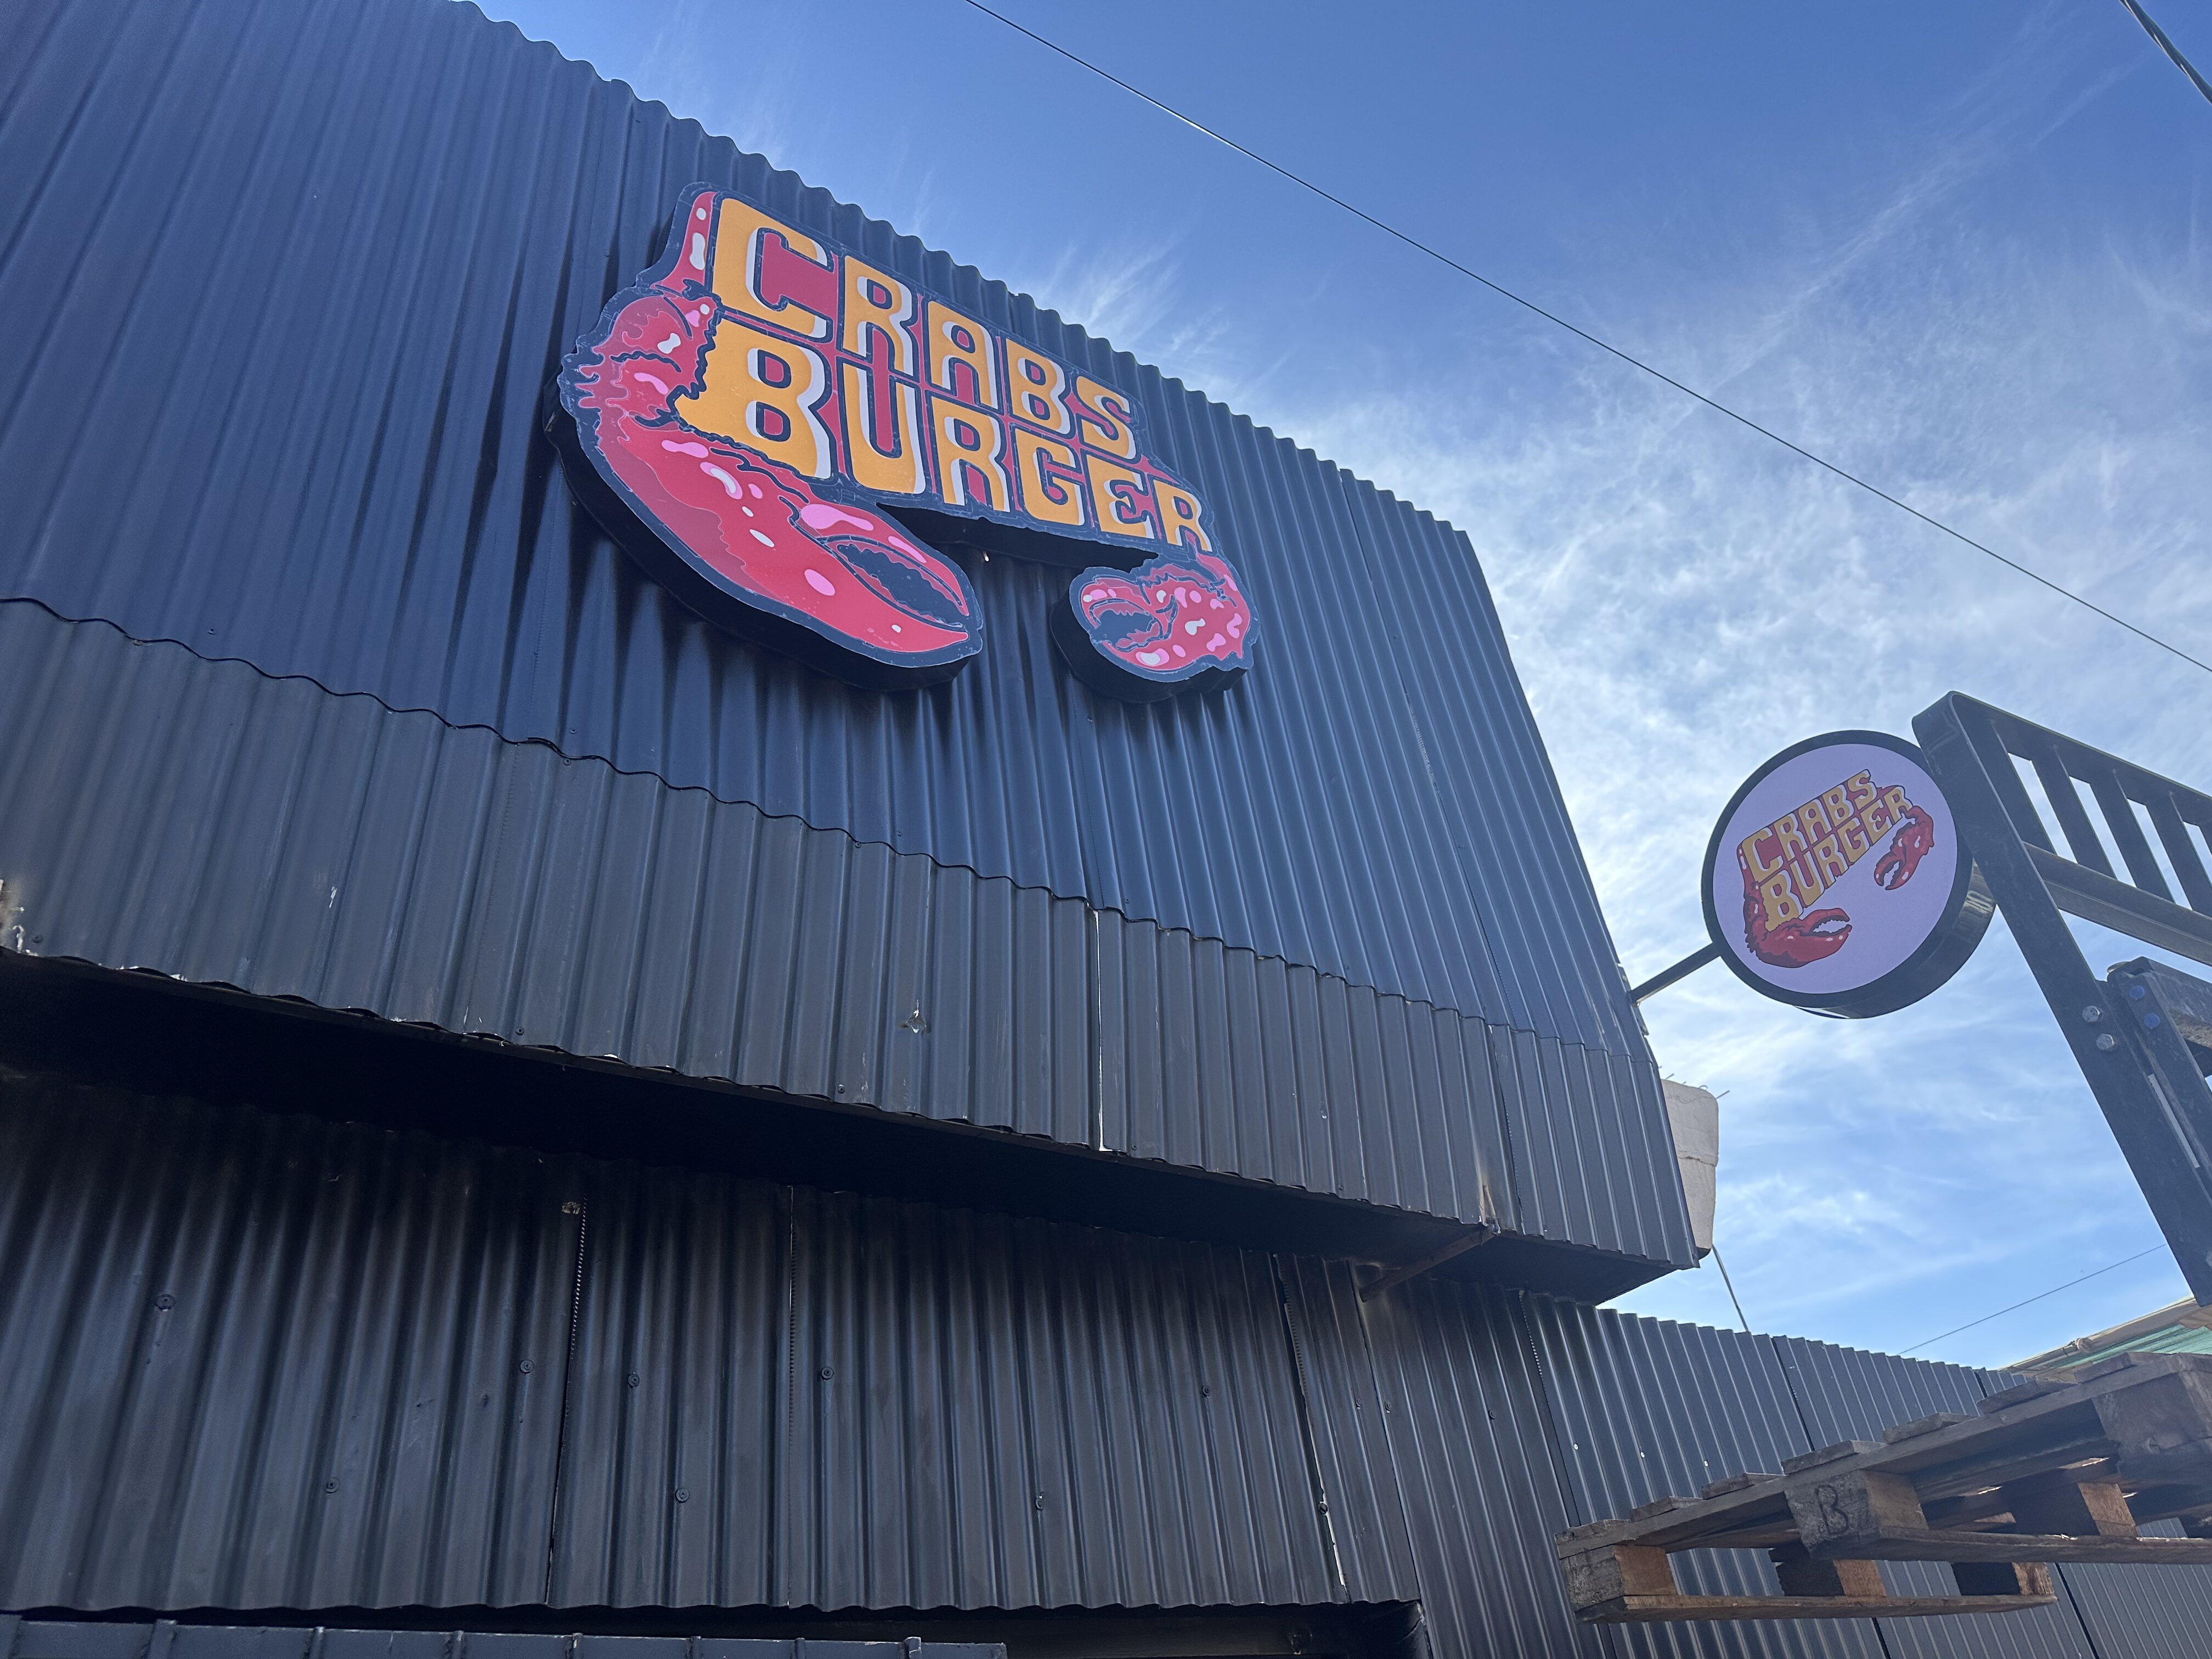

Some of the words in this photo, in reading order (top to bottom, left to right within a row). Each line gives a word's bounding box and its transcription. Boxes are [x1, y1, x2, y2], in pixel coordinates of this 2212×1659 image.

[712, 198, 1137, 460] CRABS
[674, 319, 1212, 552] BURGER
[1741, 771, 1877, 882] CRABS
[1760, 786, 1913, 932] BURGER
